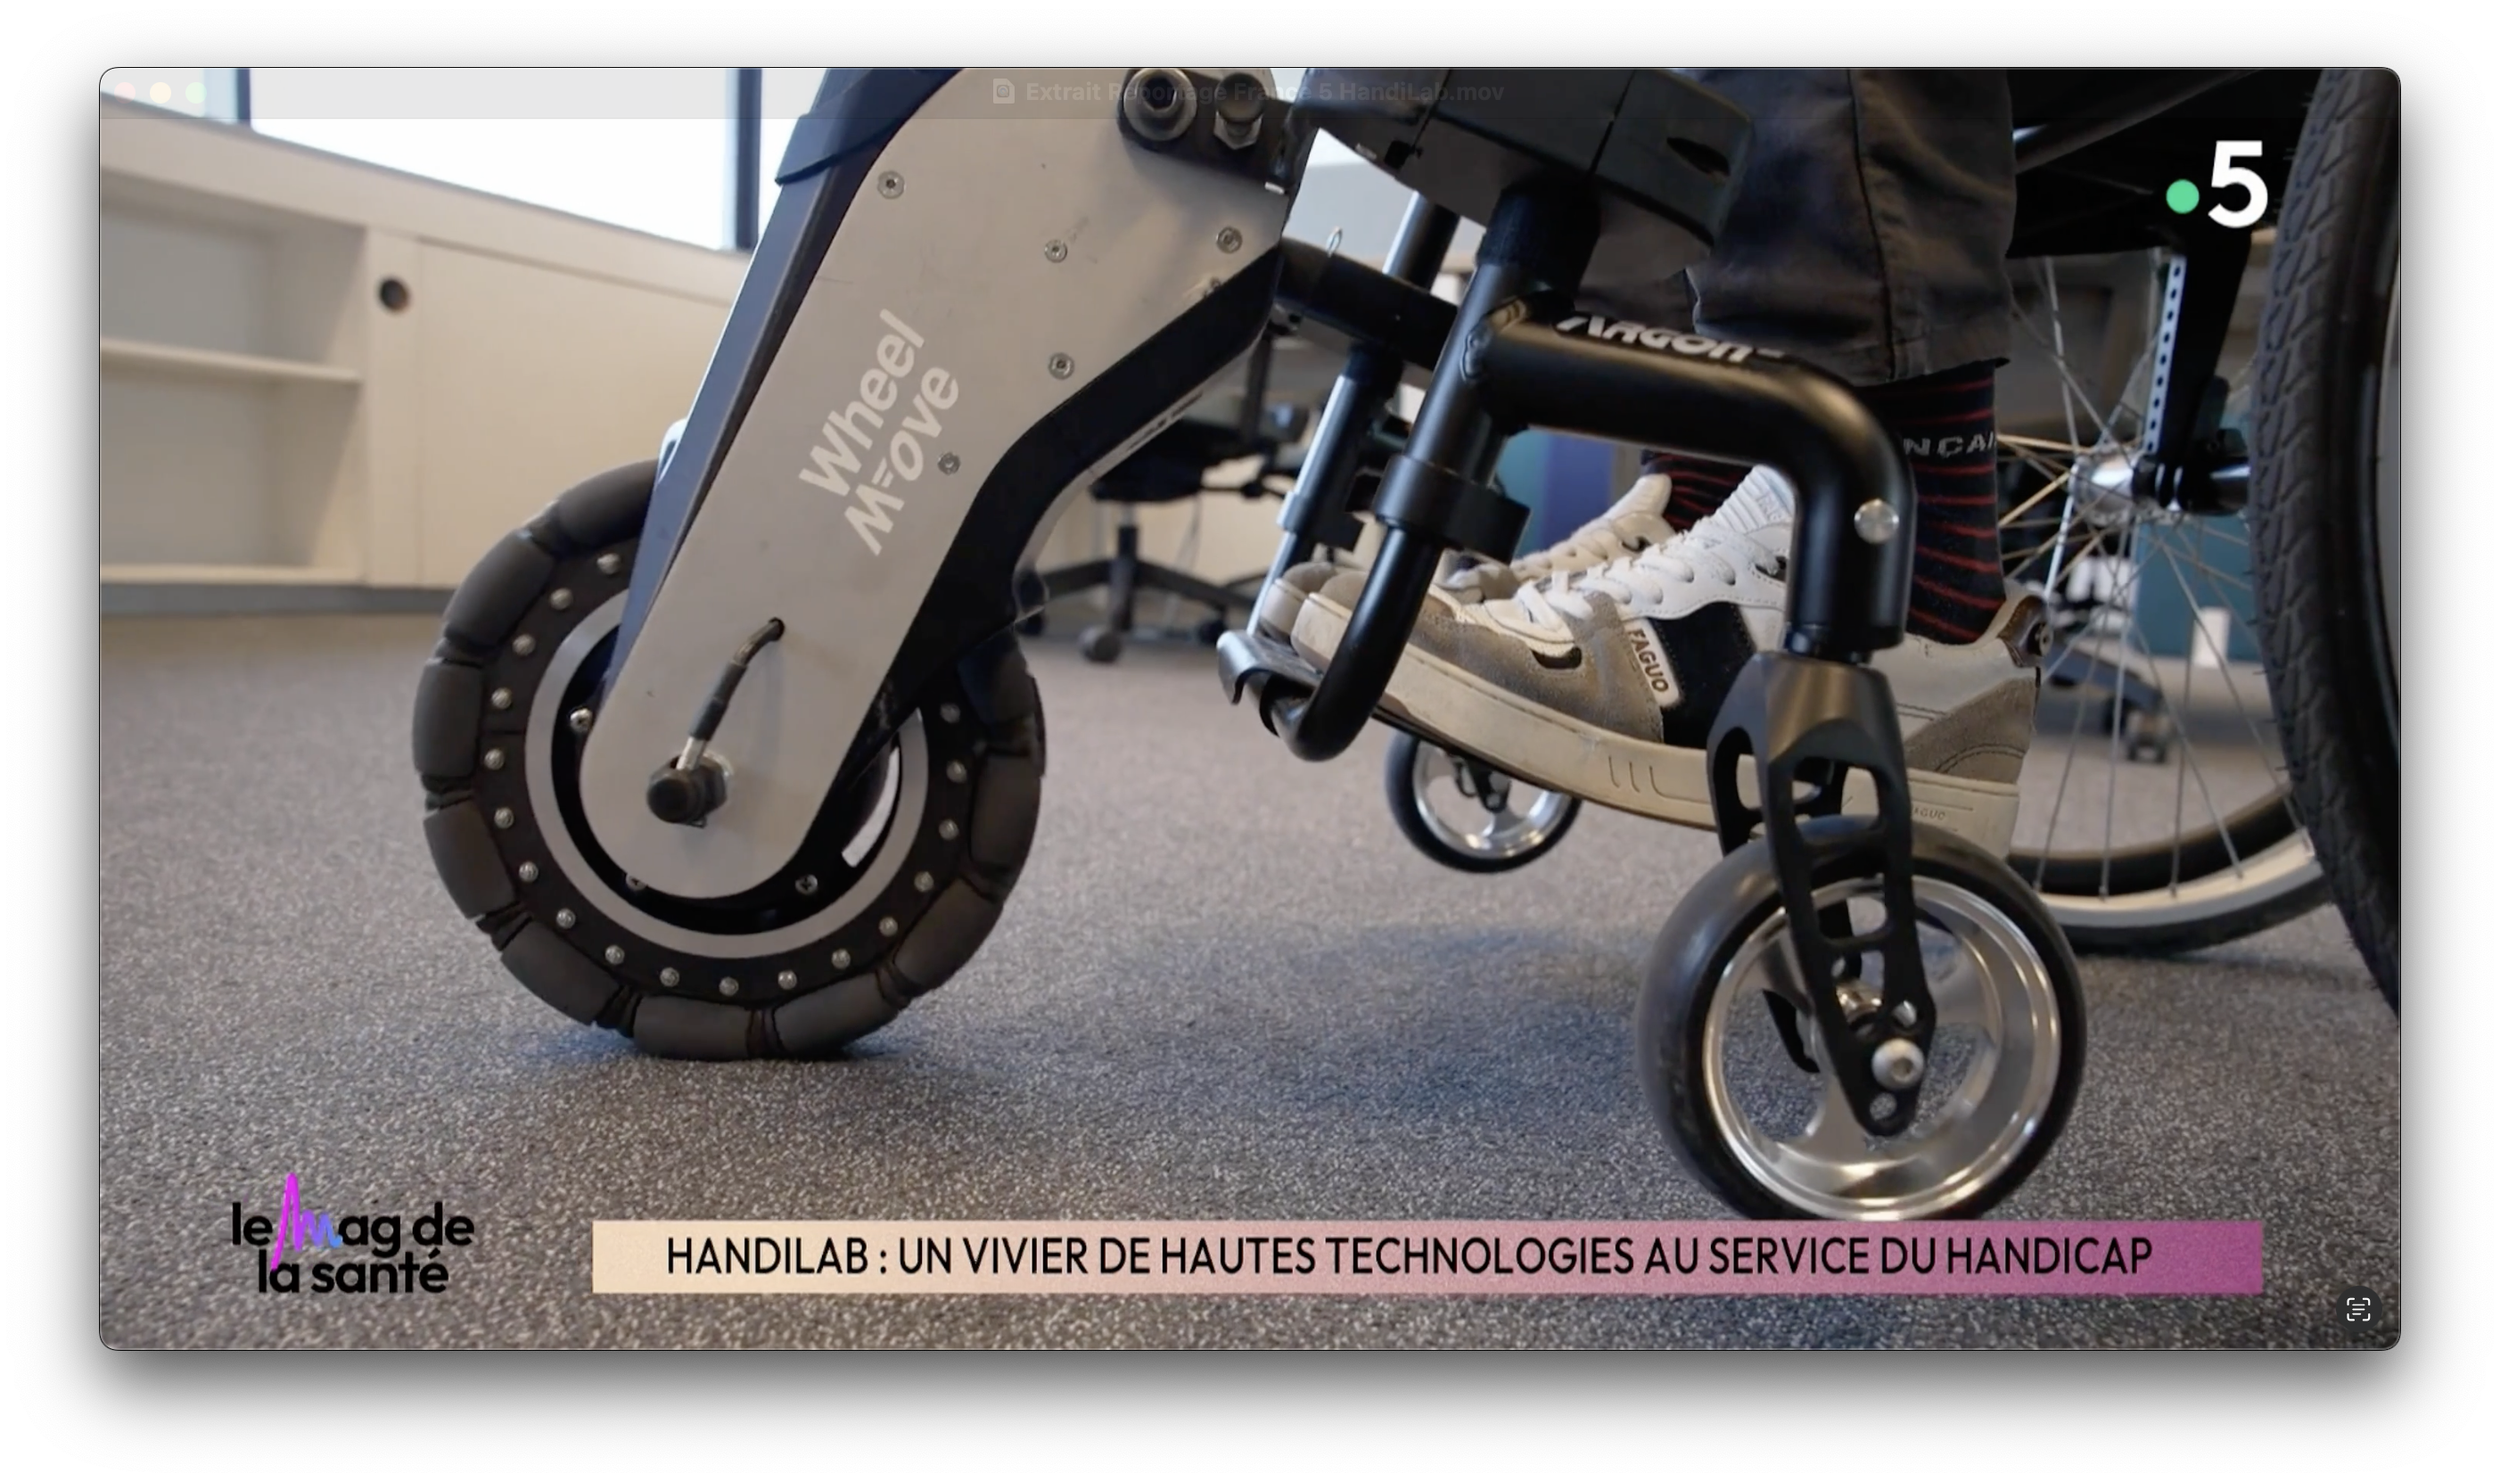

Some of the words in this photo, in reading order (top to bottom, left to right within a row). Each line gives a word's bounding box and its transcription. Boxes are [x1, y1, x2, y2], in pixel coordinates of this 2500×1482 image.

[1556, 315, 1785, 363] ARGON
[798, 308, 925, 497] Wheel
[1627, 629, 1669, 692] FAGUO
[1911, 806, 1946, 821] AGUO
